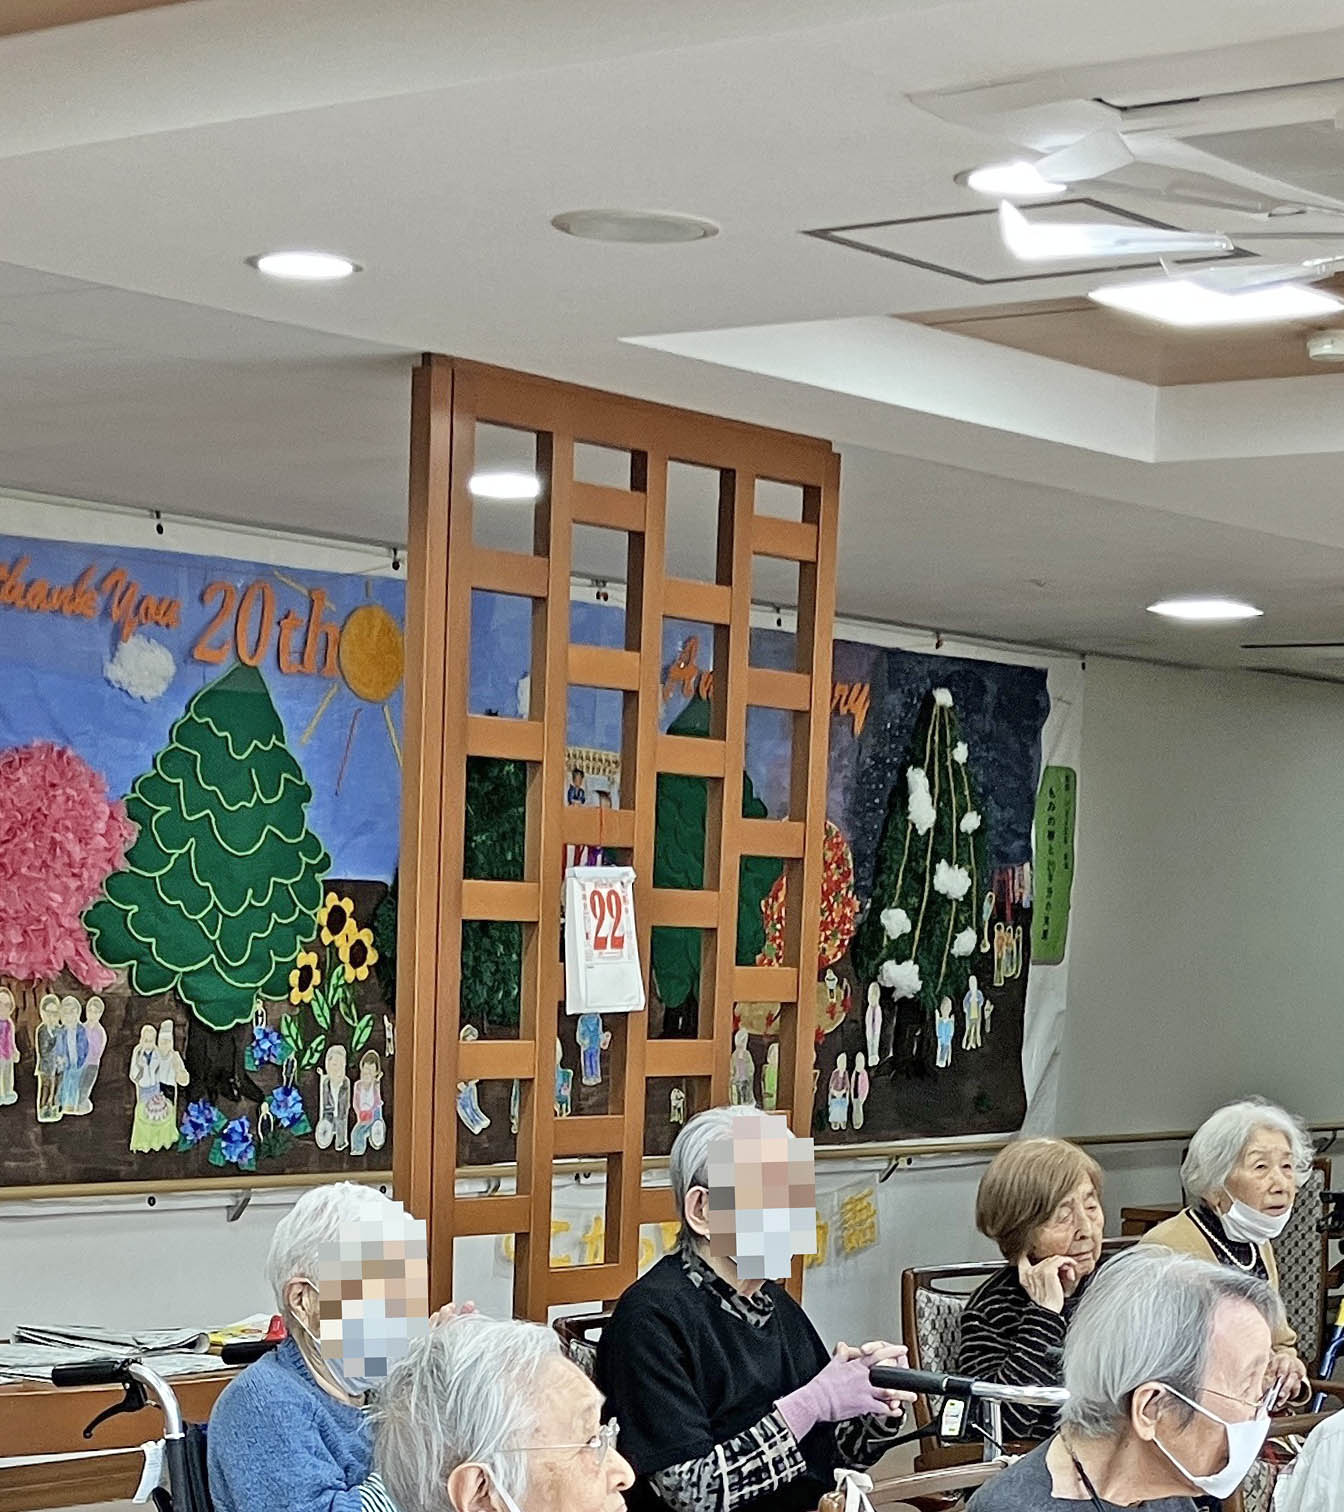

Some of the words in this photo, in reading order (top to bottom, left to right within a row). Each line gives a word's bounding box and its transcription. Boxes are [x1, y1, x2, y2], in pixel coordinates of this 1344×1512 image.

[102, 566, 182, 643] You
[193, 579, 342, 679] 20th
[589, 888, 625, 951] 22
